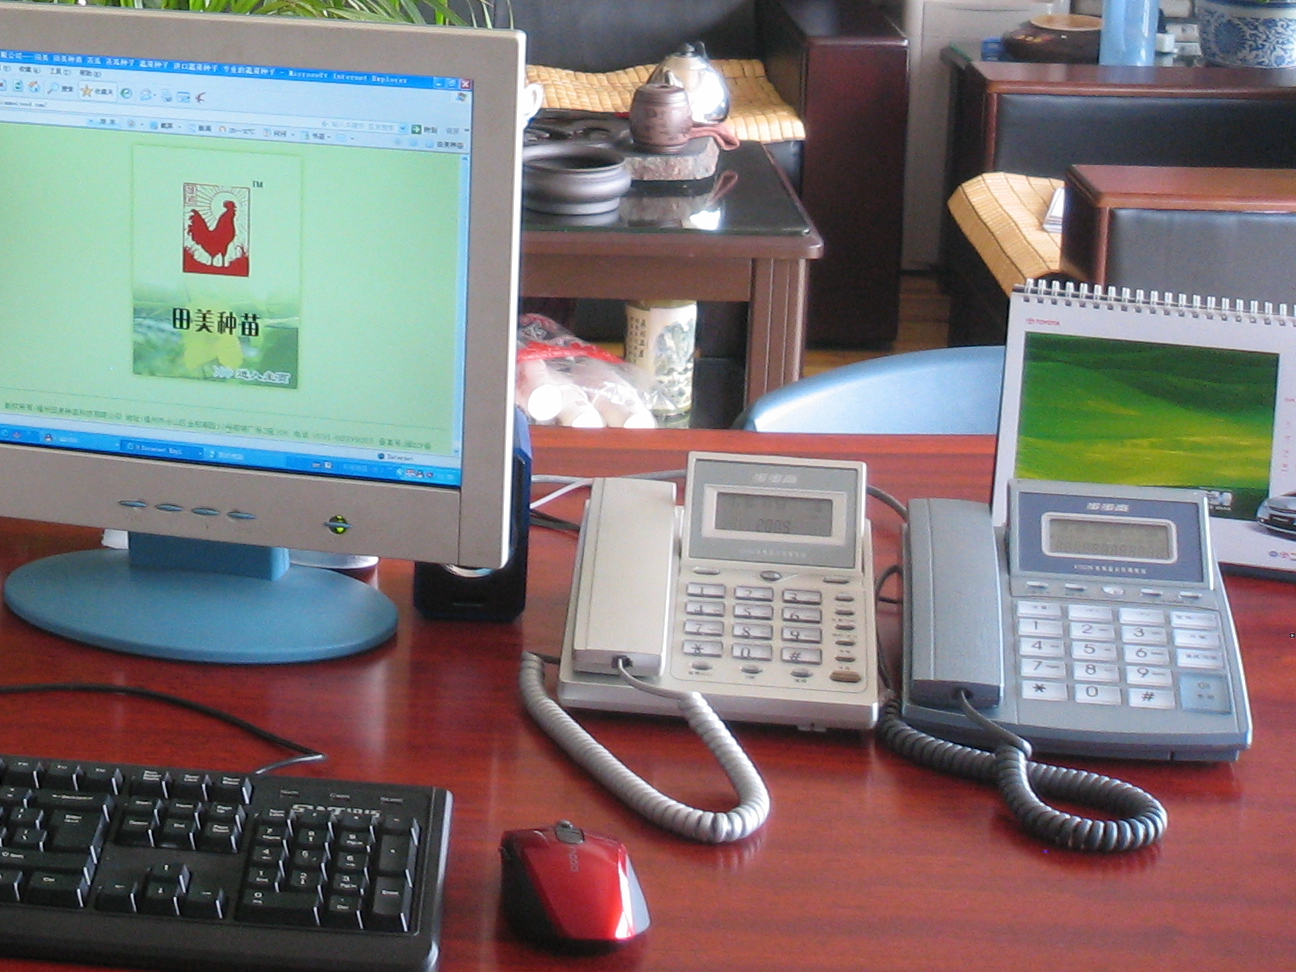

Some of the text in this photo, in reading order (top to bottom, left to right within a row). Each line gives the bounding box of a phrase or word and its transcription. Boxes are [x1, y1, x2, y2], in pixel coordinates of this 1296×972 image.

[288, 70, 329, 79] Microsoft
[332, 72, 368, 81] Internet
[371, 74, 408, 84] Explorer
[252, 180, 263, 188] TM
[172, 307, 260, 337] 田美种苗
[1086, 502, 1130, 513] 步步高
[742, 627, 751, 636] 8
[790, 630, 799, 640] 9
[1081, 624, 1092, 634] 2
[1133, 627, 1145, 637] 3
[1031, 640, 1147, 658] 4 5 6
[1033, 660, 1149, 678] 7 8 9
[1086, 686, 1155, 702] 0 #
